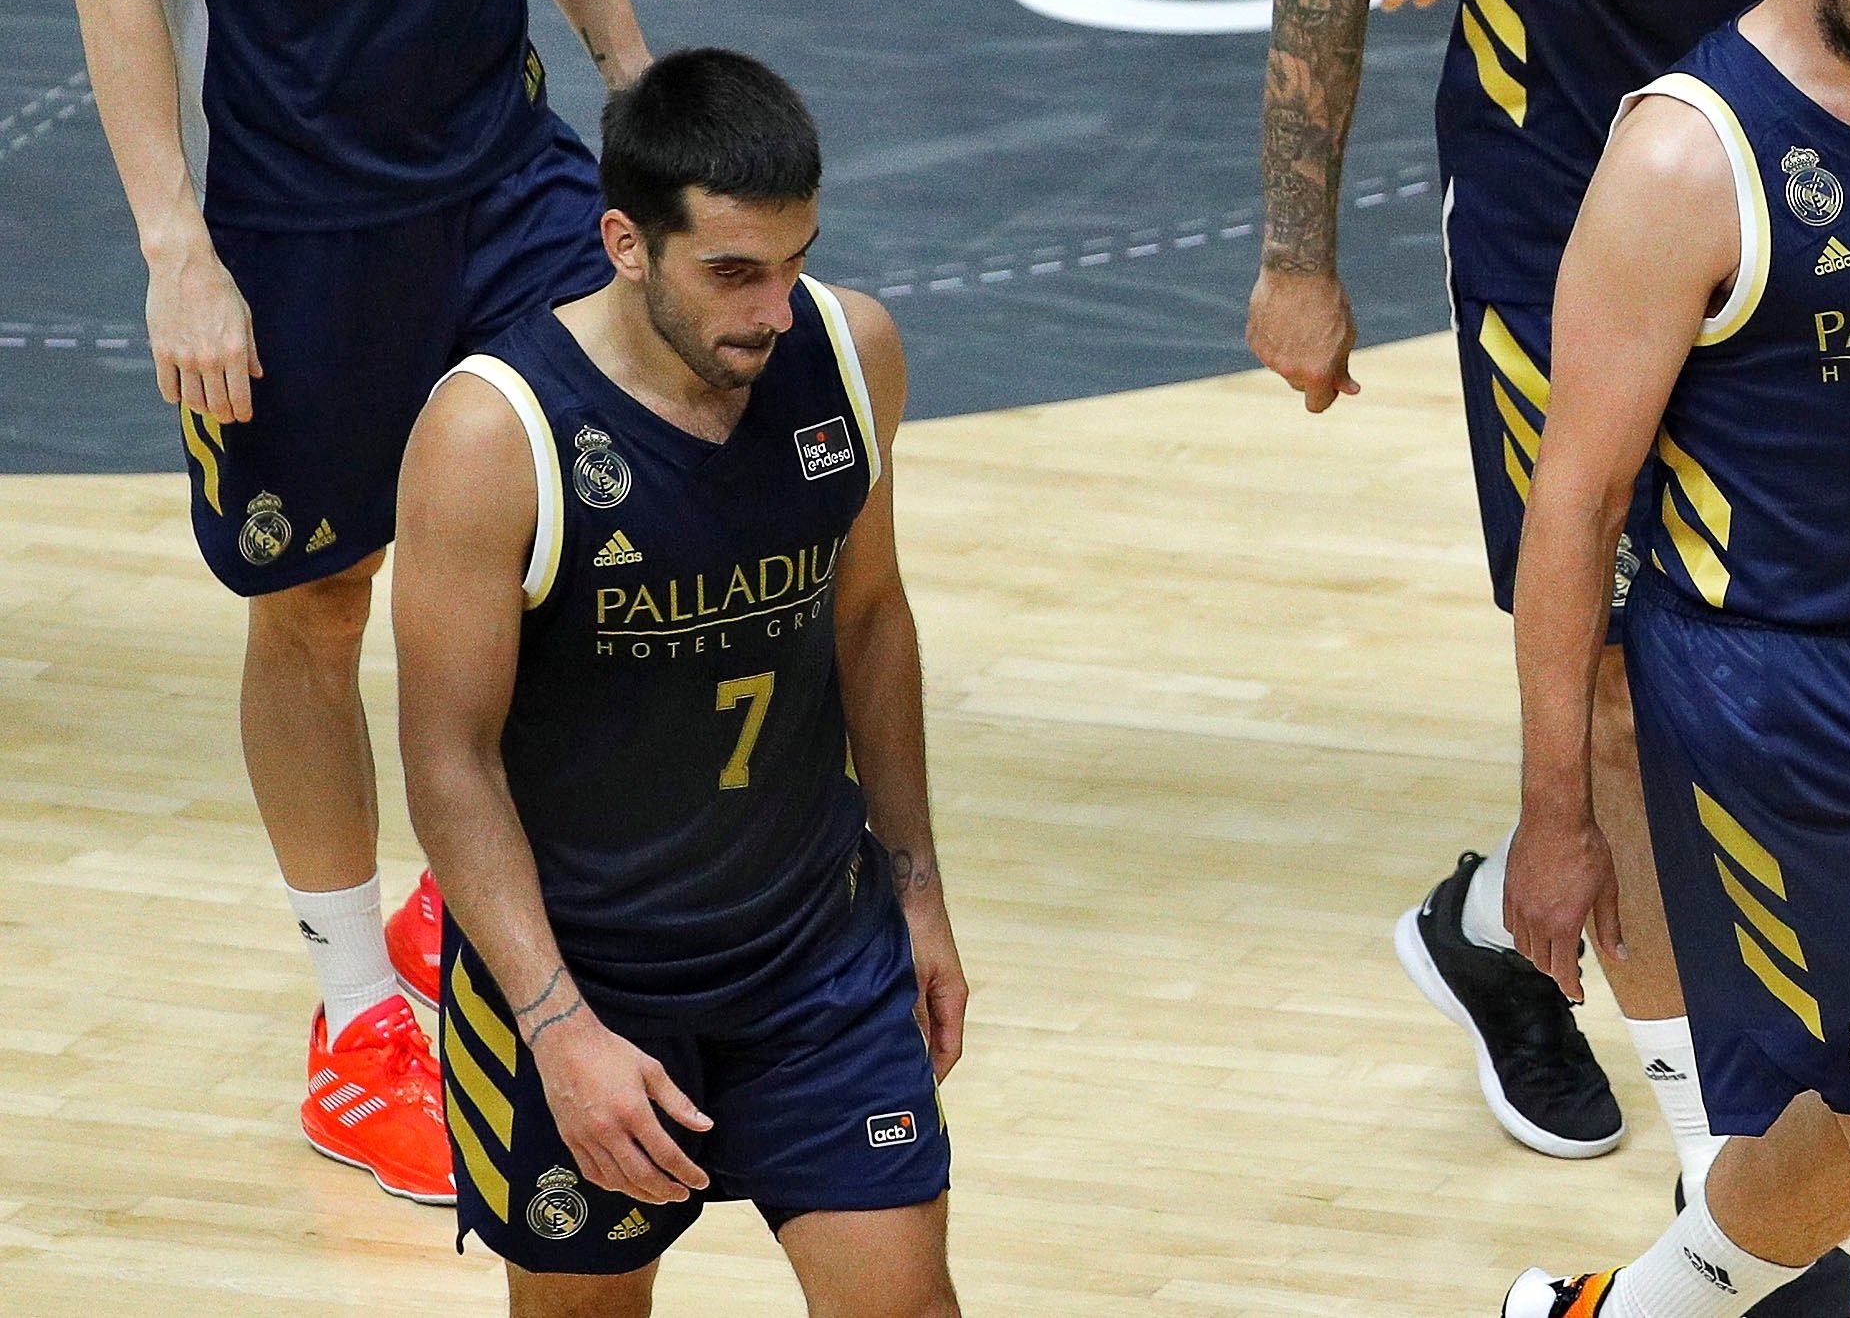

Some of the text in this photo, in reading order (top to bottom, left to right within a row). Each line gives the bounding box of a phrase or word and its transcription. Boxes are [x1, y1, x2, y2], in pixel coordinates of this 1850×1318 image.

[802, 442, 827, 459] liga
[808, 448, 851, 472] endesa
[593, 550, 643, 567] adidas
[596, 534, 848, 625] PALLADIU
[596, 600, 821, 660] HOTEL GRO
[716, 671, 775, 790] 7
[873, 1123, 907, 1142] acb
[607, 1220, 651, 1241] adidas
